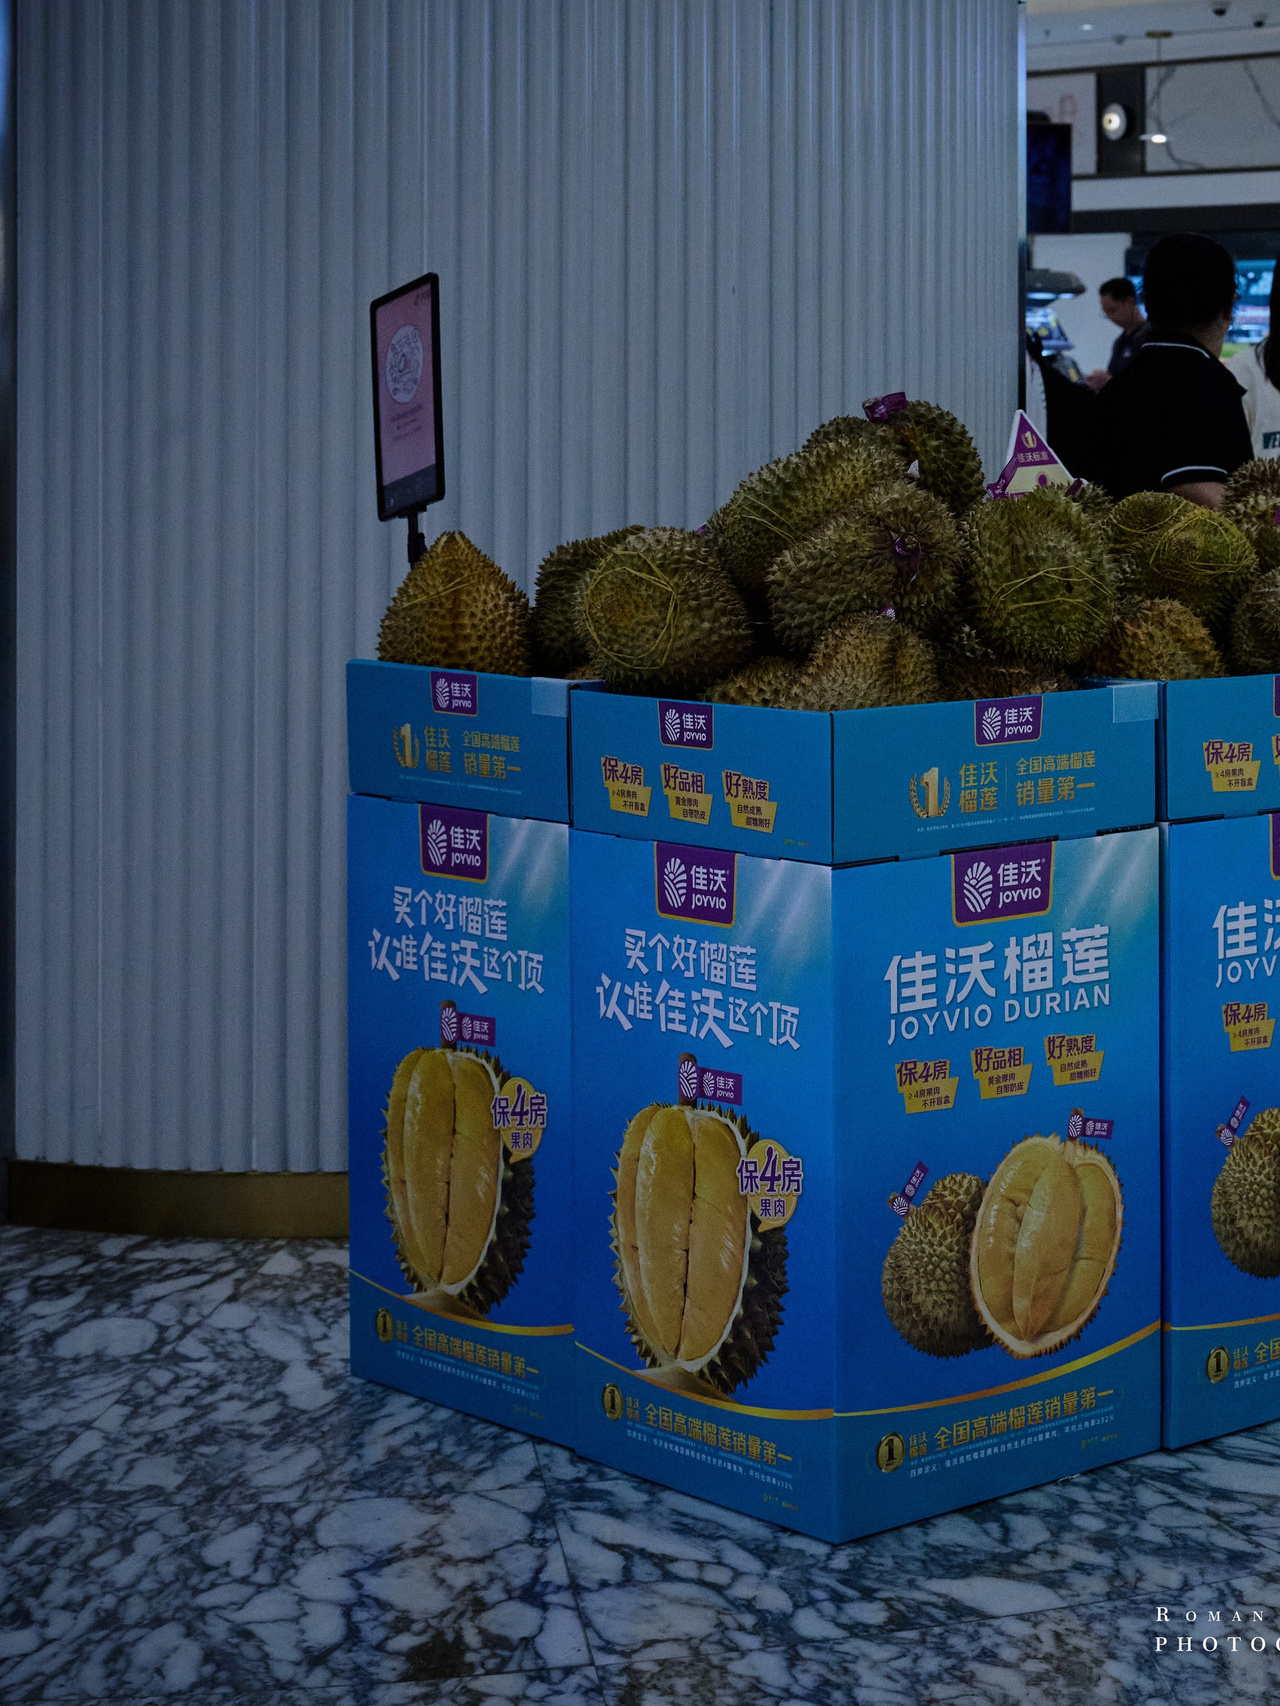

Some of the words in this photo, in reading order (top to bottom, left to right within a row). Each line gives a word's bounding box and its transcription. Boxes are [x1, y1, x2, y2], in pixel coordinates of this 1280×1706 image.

[451, 682, 472, 698] 佳沃
[452, 699, 472, 708] JOYVIO
[1004, 707, 1033, 724] 佳沃
[682, 713, 706, 730] 佳沃
[1004, 724, 1033, 738] JOYVIO
[424, 726, 450, 749] 佳沃
[683, 731, 707, 741] JOYVIO
[1015, 751, 1096, 776] 全国高端榴莲
[1205, 740, 1250, 765] 保4房
[463, 752, 521, 780] 销量第一
[603, 756, 643, 785] 保4房
[663, 764, 704, 794] 好品相
[959, 761, 999, 788] 佳沃
[725, 771, 768, 801] 好熟度
[1015, 776, 1096, 807] 销量第一
[959, 787, 998, 813] 榴莲
[450, 826, 481, 851] 佳沃
[451, 853, 481, 867] JOYVIO
[690, 865, 727, 893] 佳沃
[998, 859, 1042, 888] 佳沃
[691, 893, 727, 910] JOYVIO
[998, 887, 1041, 908] JOYVIO
[393, 885, 508, 941] 买个好榴莲
[368, 927, 545, 995] 认准佳沃这个顶
[624, 928, 757, 991] 买个好榴莲
[884, 923, 1110, 1015] 佳沃榴莲
[596, 972, 801, 1051] 认准佳沃这个顶
[887, 1004, 992, 1046] JOYVIO
[1004, 984, 1110, 1023] DURIAN
[1223, 1002, 1266, 1027] 保4房
[473, 1020, 489, 1034] 佳沃
[1047, 1034, 1095, 1060] 好熟度
[897, 1059, 948, 1087] 保4房
[974, 1047, 1022, 1074] 好品相
[716, 1075, 735, 1091] 佳沃
[491, 1083, 547, 1127] 保4房
[510, 1131, 533, 1149] 果肉
[737, 1146, 802, 1193] 保4房
[760, 1198, 786, 1218] 果肉
[934, 1386, 1114, 1451] 全国高端榴莲销量第一
[644, 1402, 793, 1466] 全国高端榴莲销量第一
[909, 1431, 928, 1446] 佳沃
